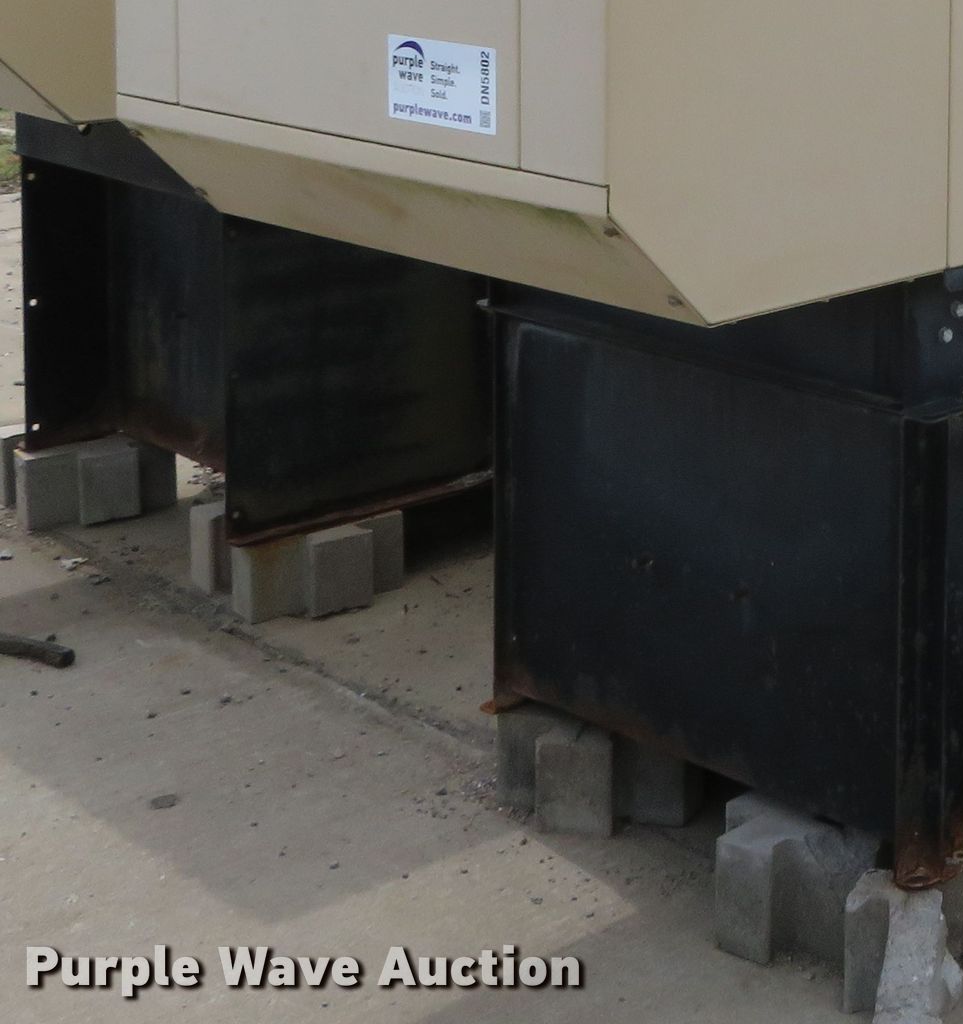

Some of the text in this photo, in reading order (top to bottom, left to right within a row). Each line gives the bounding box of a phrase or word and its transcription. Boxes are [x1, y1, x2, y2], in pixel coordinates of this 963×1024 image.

[392, 55, 424, 70] purple
[399, 70, 423, 82] wave
[480, 51, 490, 105] DN5802
[393, 102, 472, 124] purplewave.com
